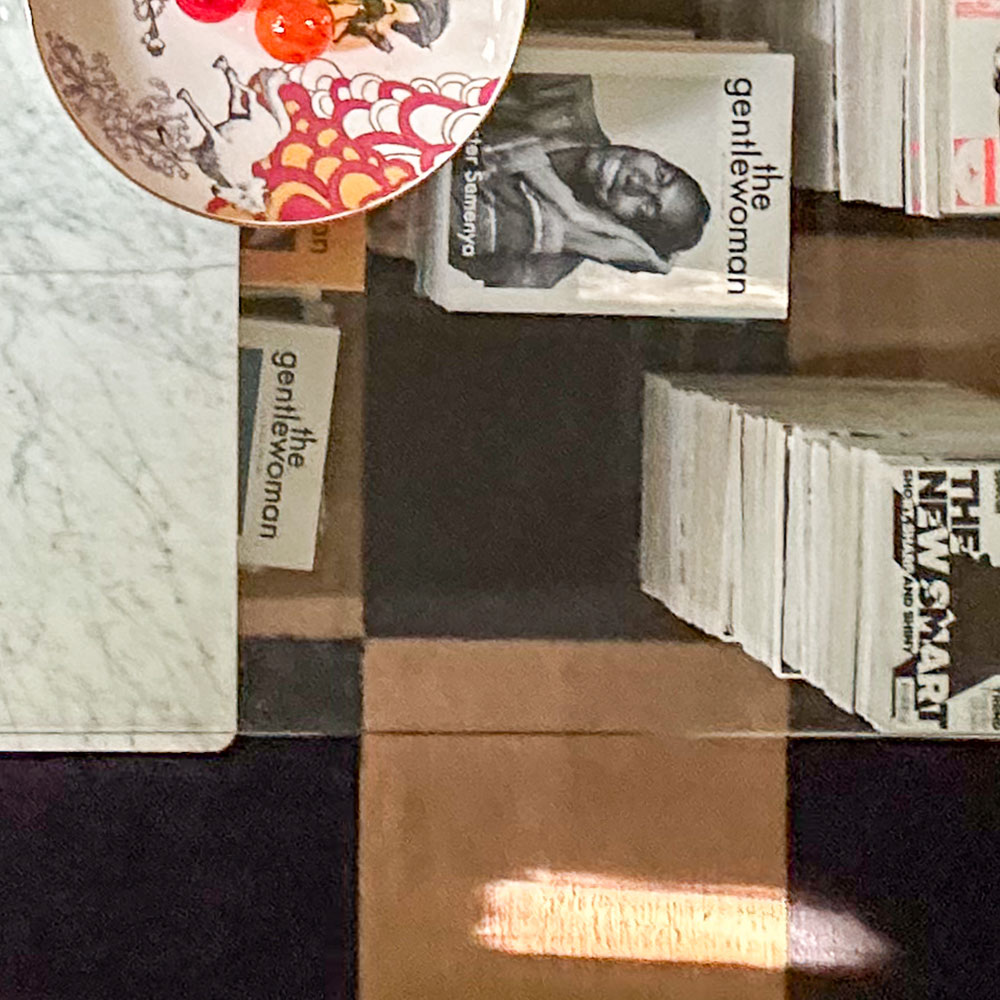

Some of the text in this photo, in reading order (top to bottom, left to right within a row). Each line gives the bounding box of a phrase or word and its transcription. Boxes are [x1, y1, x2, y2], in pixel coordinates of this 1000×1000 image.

[724, 77, 762, 296] gentlewoman
[752, 164, 784, 211] the
[259, 351, 301, 539] gentlewoman
[288, 427, 318, 468] the
[950, 469, 980, 556] THE
[903, 576, 915, 608] AND
[916, 470, 954, 730] NEW SMART
